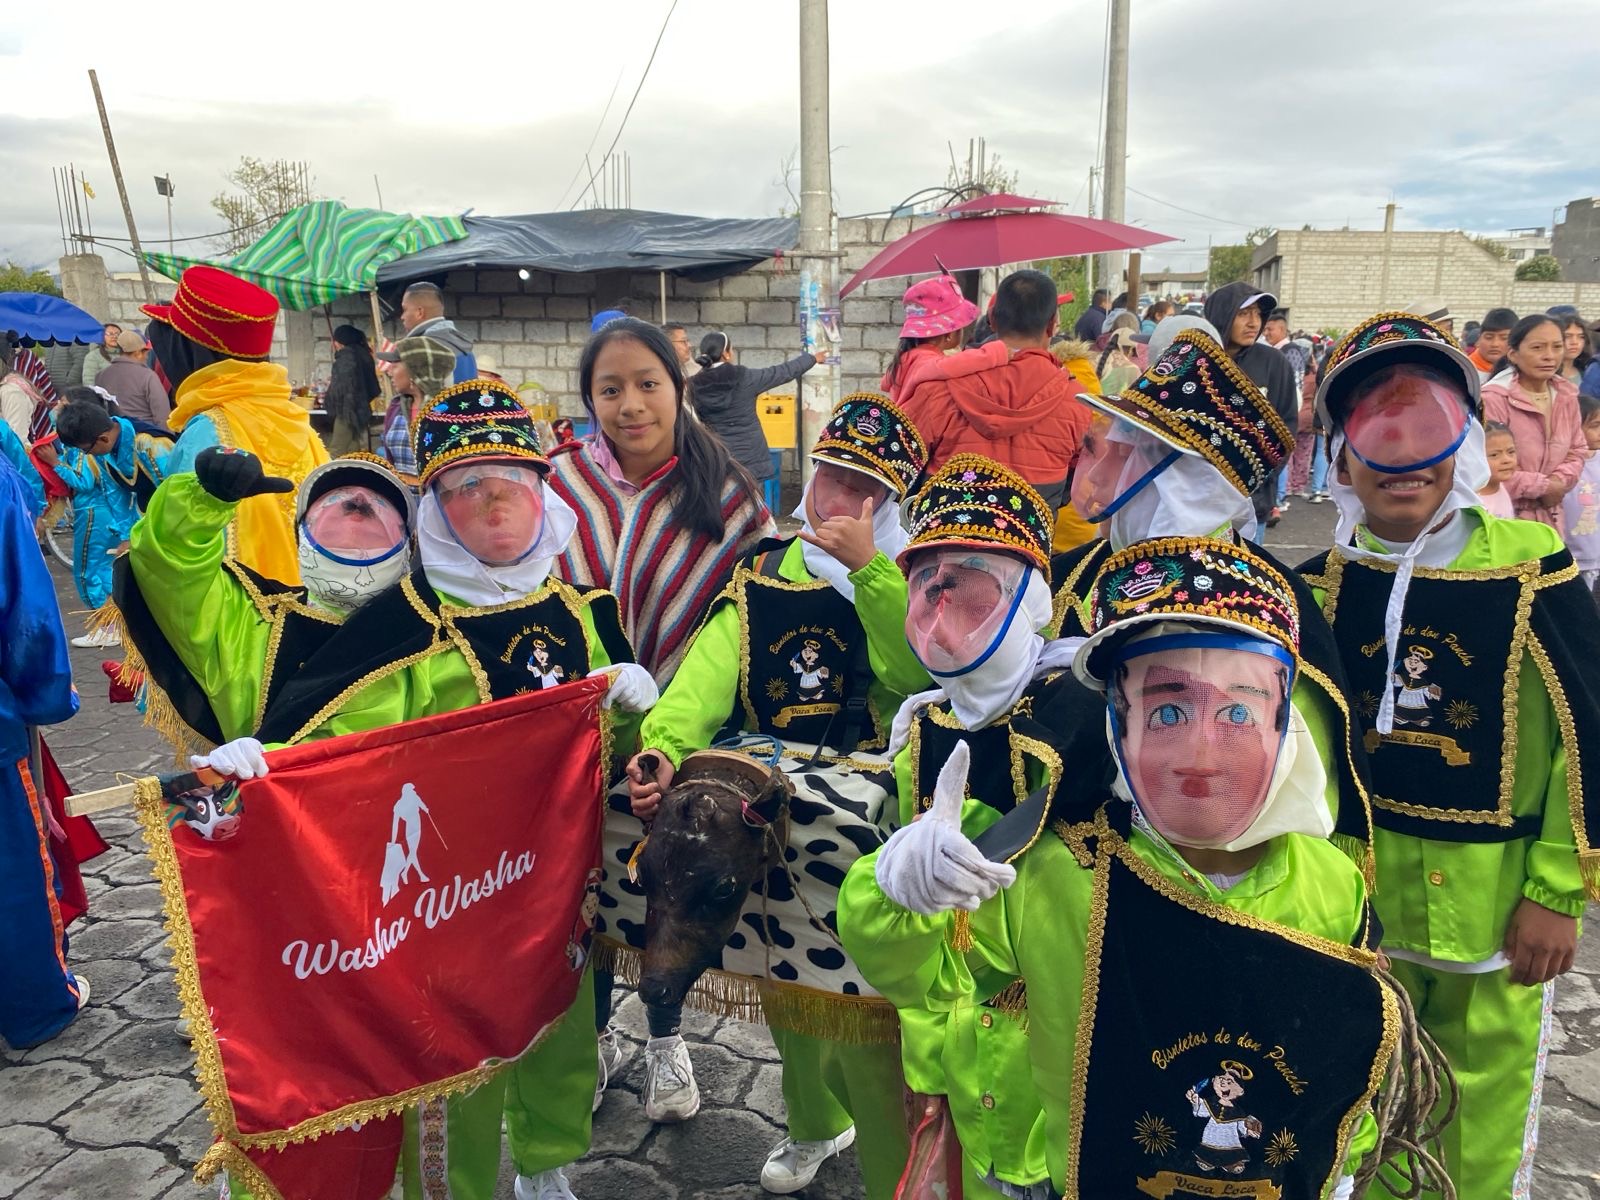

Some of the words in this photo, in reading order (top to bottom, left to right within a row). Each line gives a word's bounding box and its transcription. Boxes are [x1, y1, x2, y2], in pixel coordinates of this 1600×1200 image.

[1403, 623, 1416, 636] de
[1420, 625, 1440, 640] don
[1441, 633, 1475, 667] Pancho
[281, 916, 411, 980] Washa
[413, 850, 536, 930] Washa
[1151, 1031, 1208, 1070] Bisnietos
[1214, 1026, 1231, 1044] de
[1236, 1031, 1262, 1052] don
[1175, 1175, 1214, 1194] Vaca
[1221, 1183, 1256, 1195] Loca
